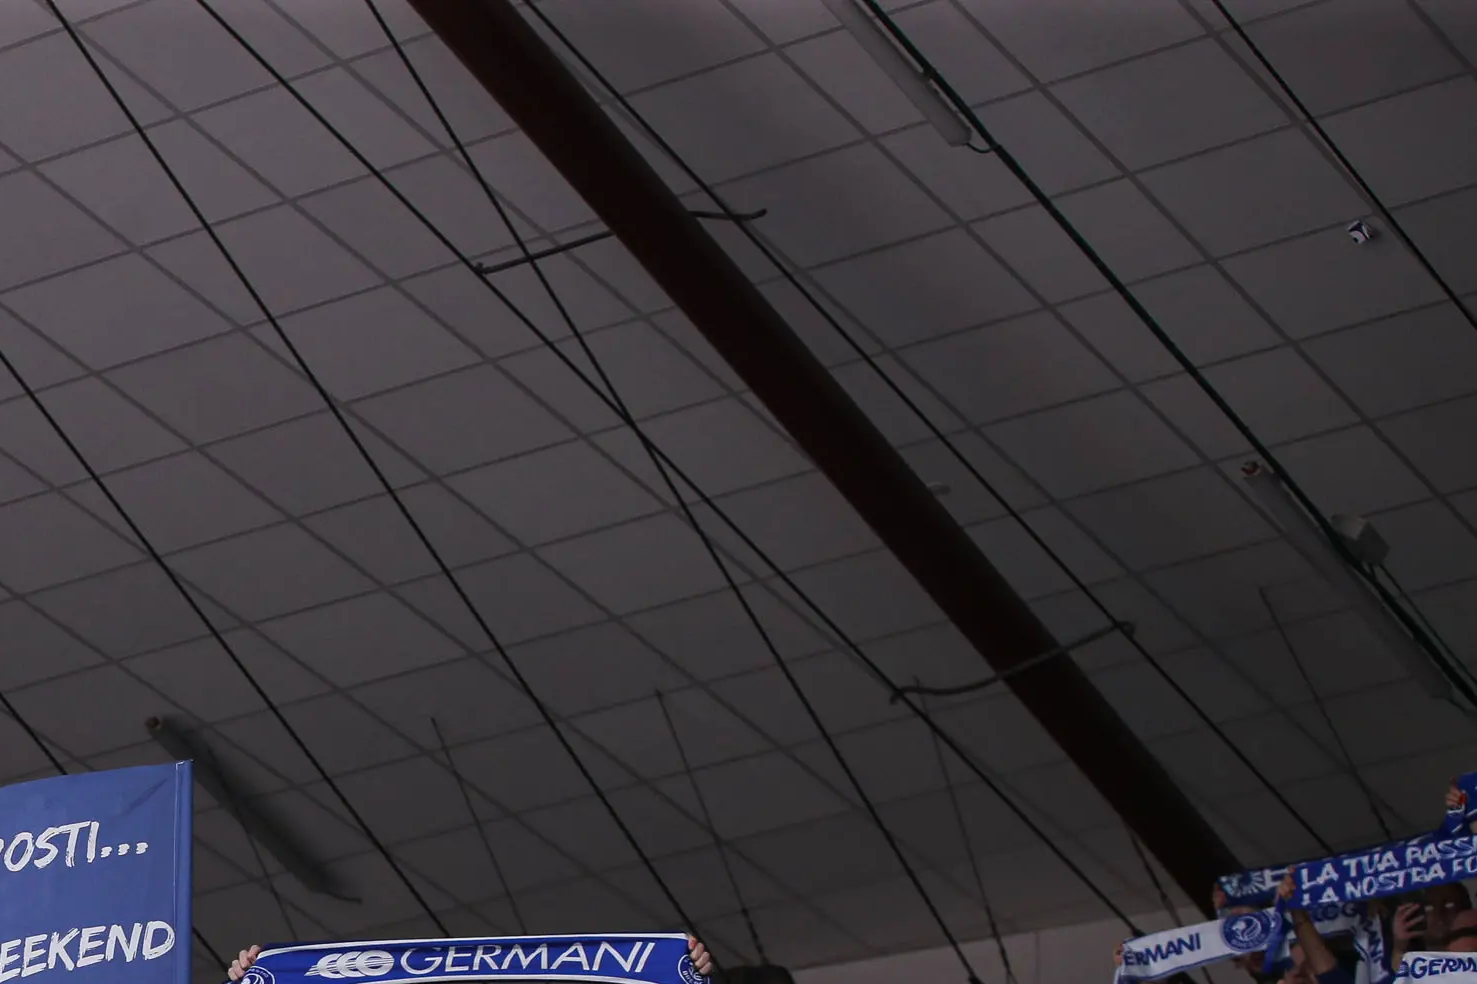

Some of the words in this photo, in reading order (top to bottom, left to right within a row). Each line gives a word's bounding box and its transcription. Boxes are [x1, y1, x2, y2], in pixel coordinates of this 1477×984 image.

[1301, 862, 1339, 890] LA
[1342, 849, 1400, 877] TUA
[1345, 866, 1446, 898] NOSTRA
[400, 940, 656, 976] GERMANI
